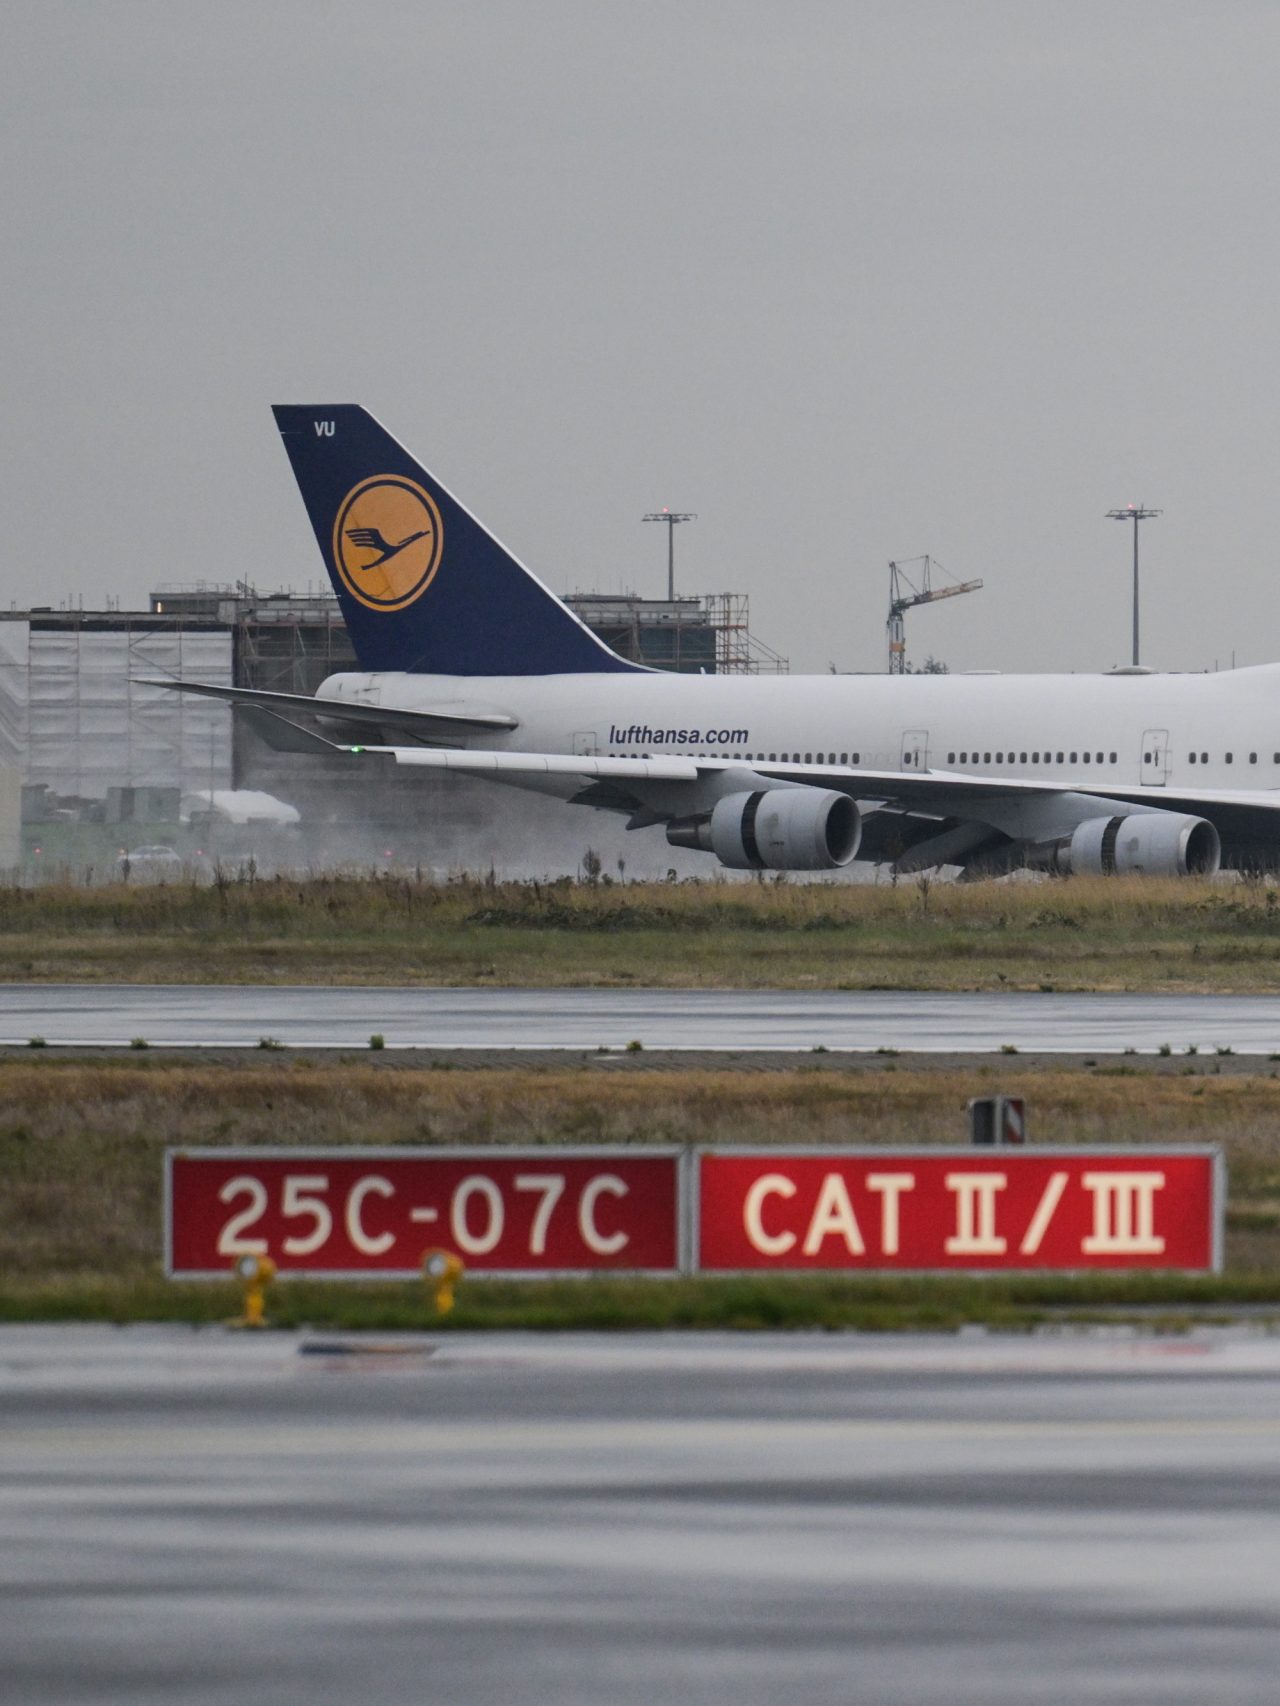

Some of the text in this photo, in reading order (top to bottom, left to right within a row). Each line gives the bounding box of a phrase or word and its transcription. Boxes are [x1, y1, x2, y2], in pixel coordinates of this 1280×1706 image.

[314, 421, 335, 437] VU
[609, 725, 749, 744] lufthansa.com
[218, 1174, 630, 1256] 25C-07C
[743, 1172, 916, 1256] CAT
